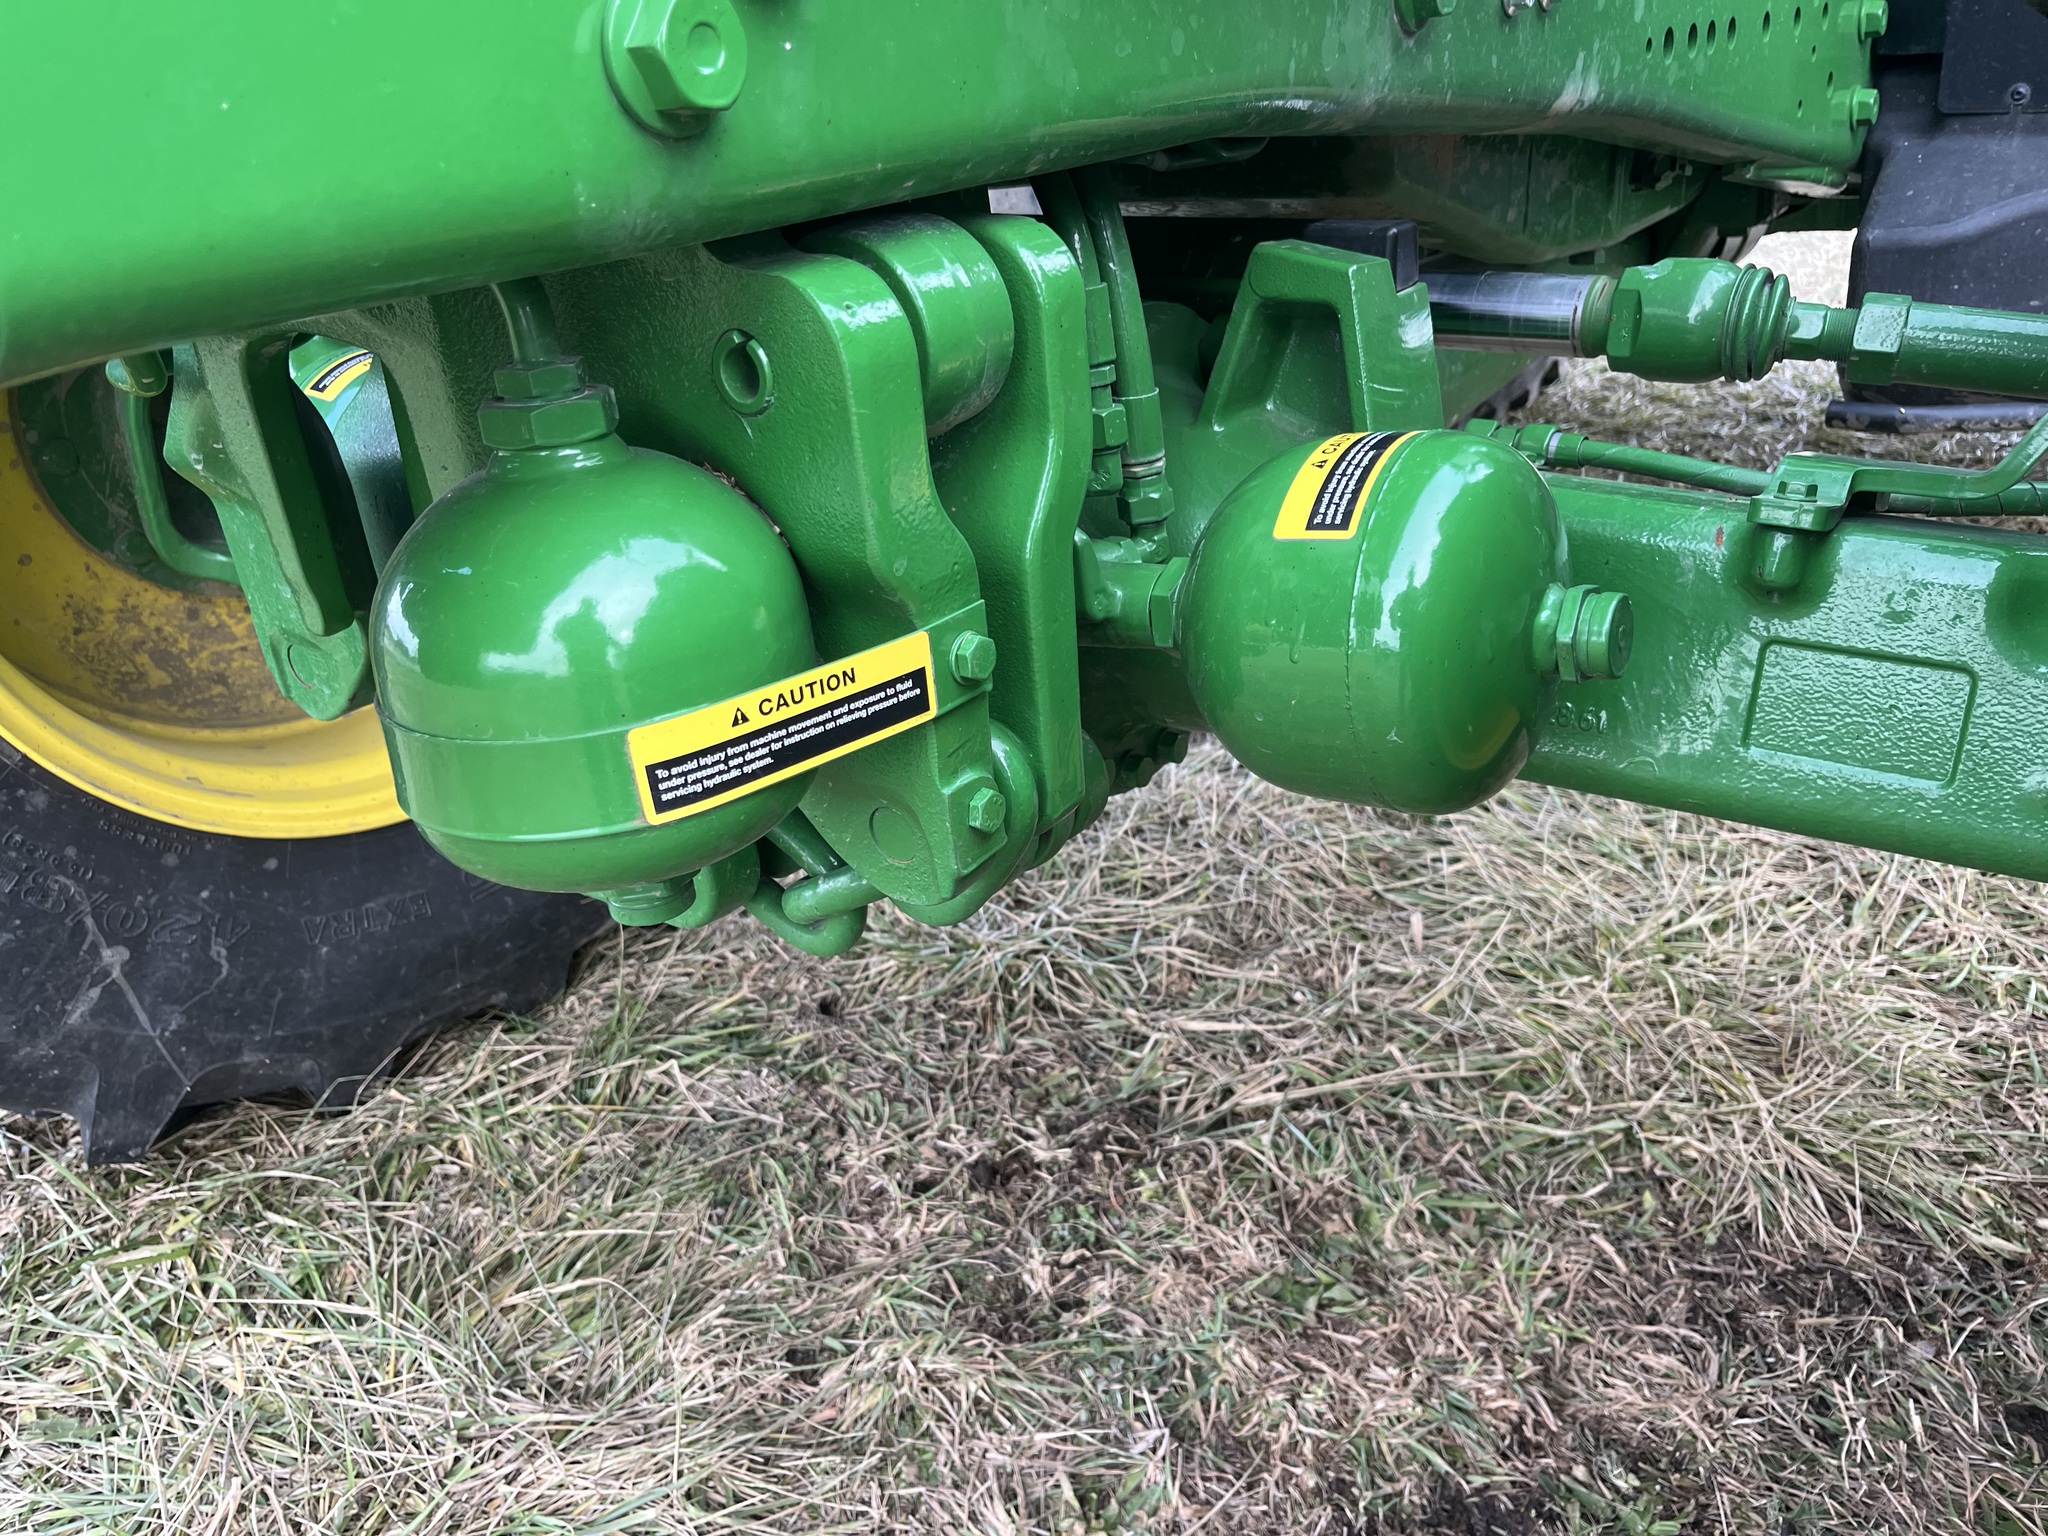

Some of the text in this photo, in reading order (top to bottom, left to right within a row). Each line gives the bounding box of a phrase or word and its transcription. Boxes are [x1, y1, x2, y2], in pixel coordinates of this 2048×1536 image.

[1313, 513, 1323, 525] To
[1319, 493, 1331, 514] avoid
[1325, 474, 1341, 493] injury
[1324, 503, 1336, 525] under
[1334, 493, 1352, 525] servicing
[758, 667, 856, 716] CAUTION
[655, 678, 913, 779] To avoid injury from machine movement and exposure to fluid
[658, 687, 921, 791] under pressure, see dealer for instruction on relieving pressure before
[660, 756, 775, 802] servicing hydraulic system.
[301, 890, 432, 945] EXTRA
